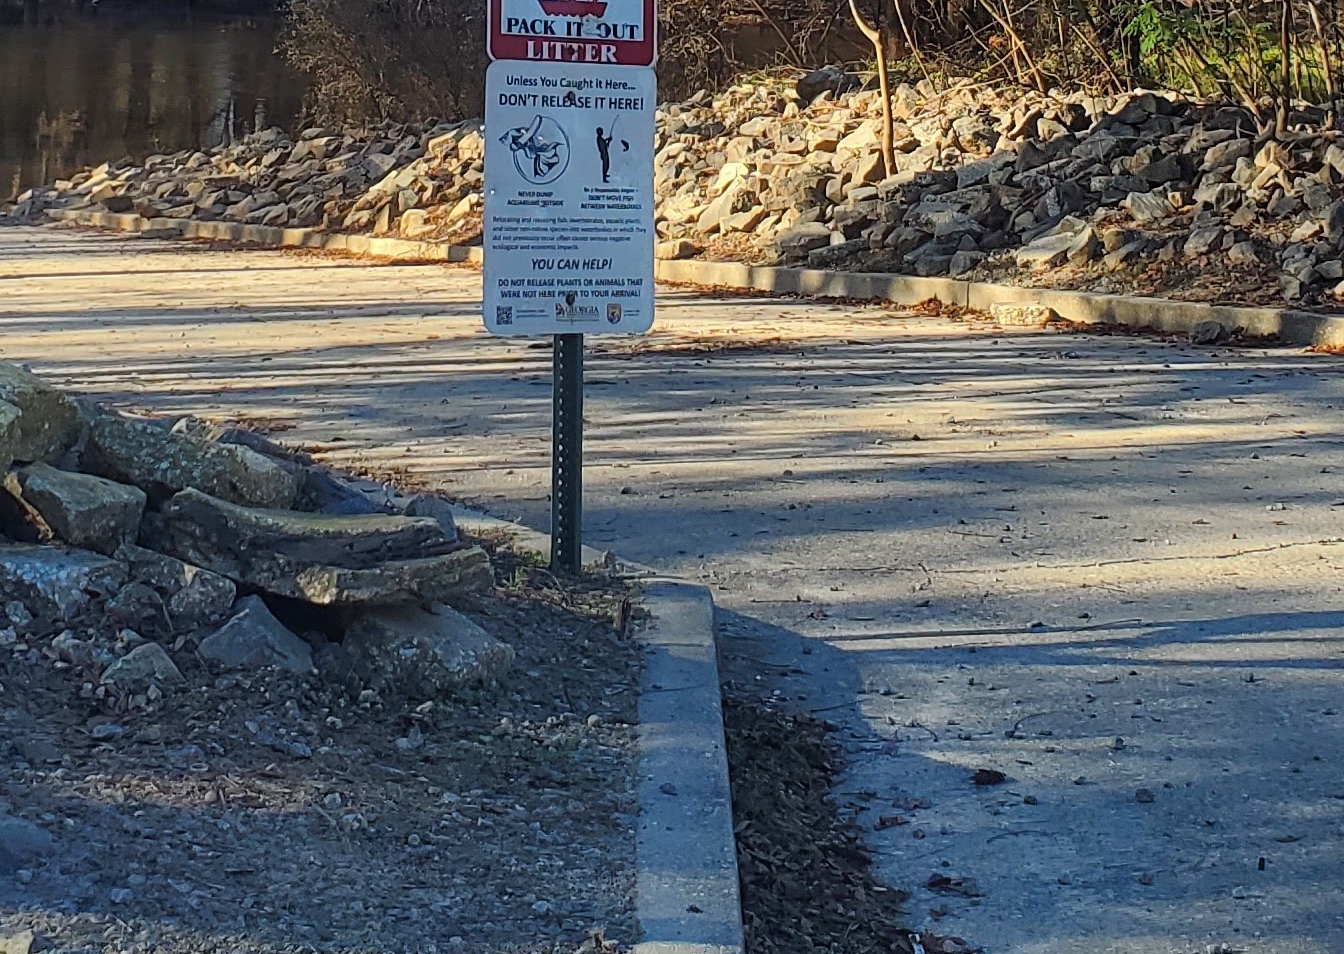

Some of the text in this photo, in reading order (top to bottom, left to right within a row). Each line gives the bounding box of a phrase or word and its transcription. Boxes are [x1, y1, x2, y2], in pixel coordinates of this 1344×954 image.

[507, 17, 639, 39] PACK IT OUT
[527, 40, 618, 62] LITTER
[506, 75, 636, 90] Unless You Caught it Here...
[499, 93, 644, 111] DON'T RELEASE IT HERE!
[531, 258, 613, 271] YOU CAN HELP!
[498, 278, 643, 287] DO NOT RELEASE PLANTS OR ANIMALS THAT
[500, 289, 641, 298] WERE NOT HERE PRIOR TO YOUR ARRIVAL!
